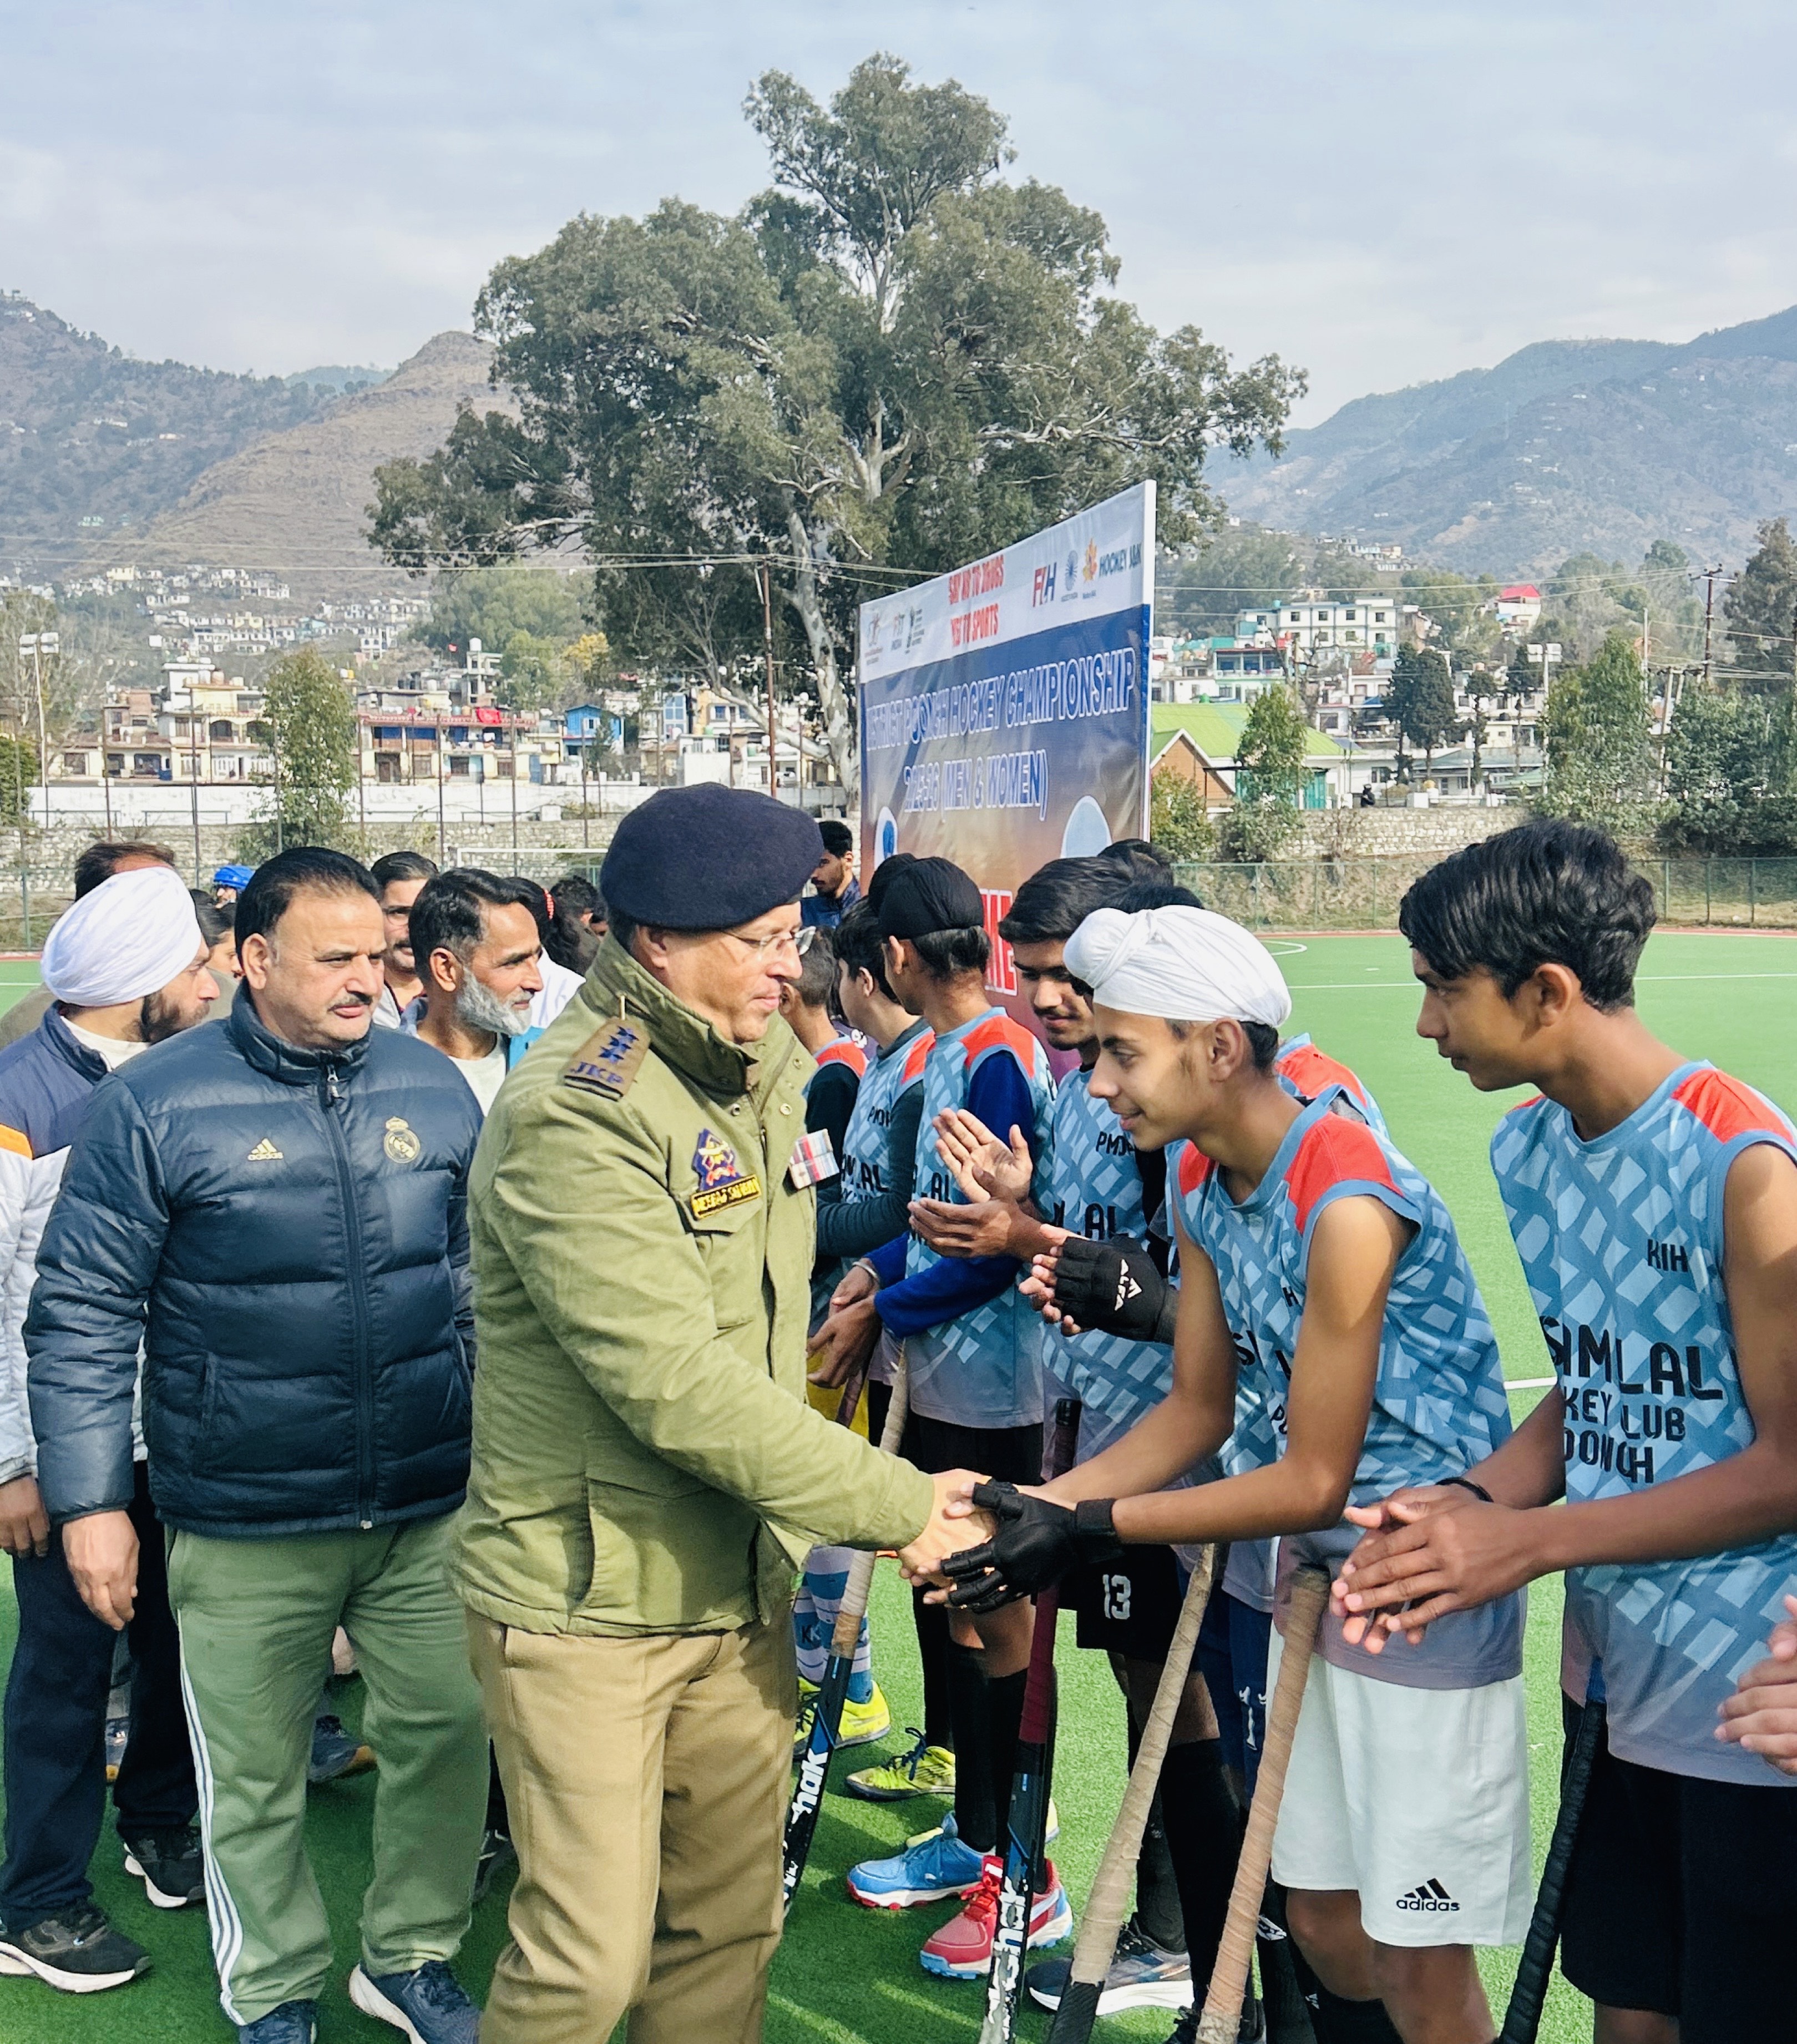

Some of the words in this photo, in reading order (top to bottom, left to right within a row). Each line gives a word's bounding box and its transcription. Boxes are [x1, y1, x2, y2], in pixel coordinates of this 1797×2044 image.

[972, 603, 999, 641] SPORTS
[949, 674, 1006, 737] HOCKEY
[1005, 647, 1136, 728] CHAMPIONSHIP
[973, 756, 984, 809] &
[986, 749, 1049, 822] WOMEN)
[569, 1061, 624, 1083] JKP
[1564, 1385, 1612, 1426] KEY
[1621, 1404, 1686, 1441] LUB
[1102, 1574, 1132, 1620] 13
[1396, 1898, 1461, 1911] adidas
